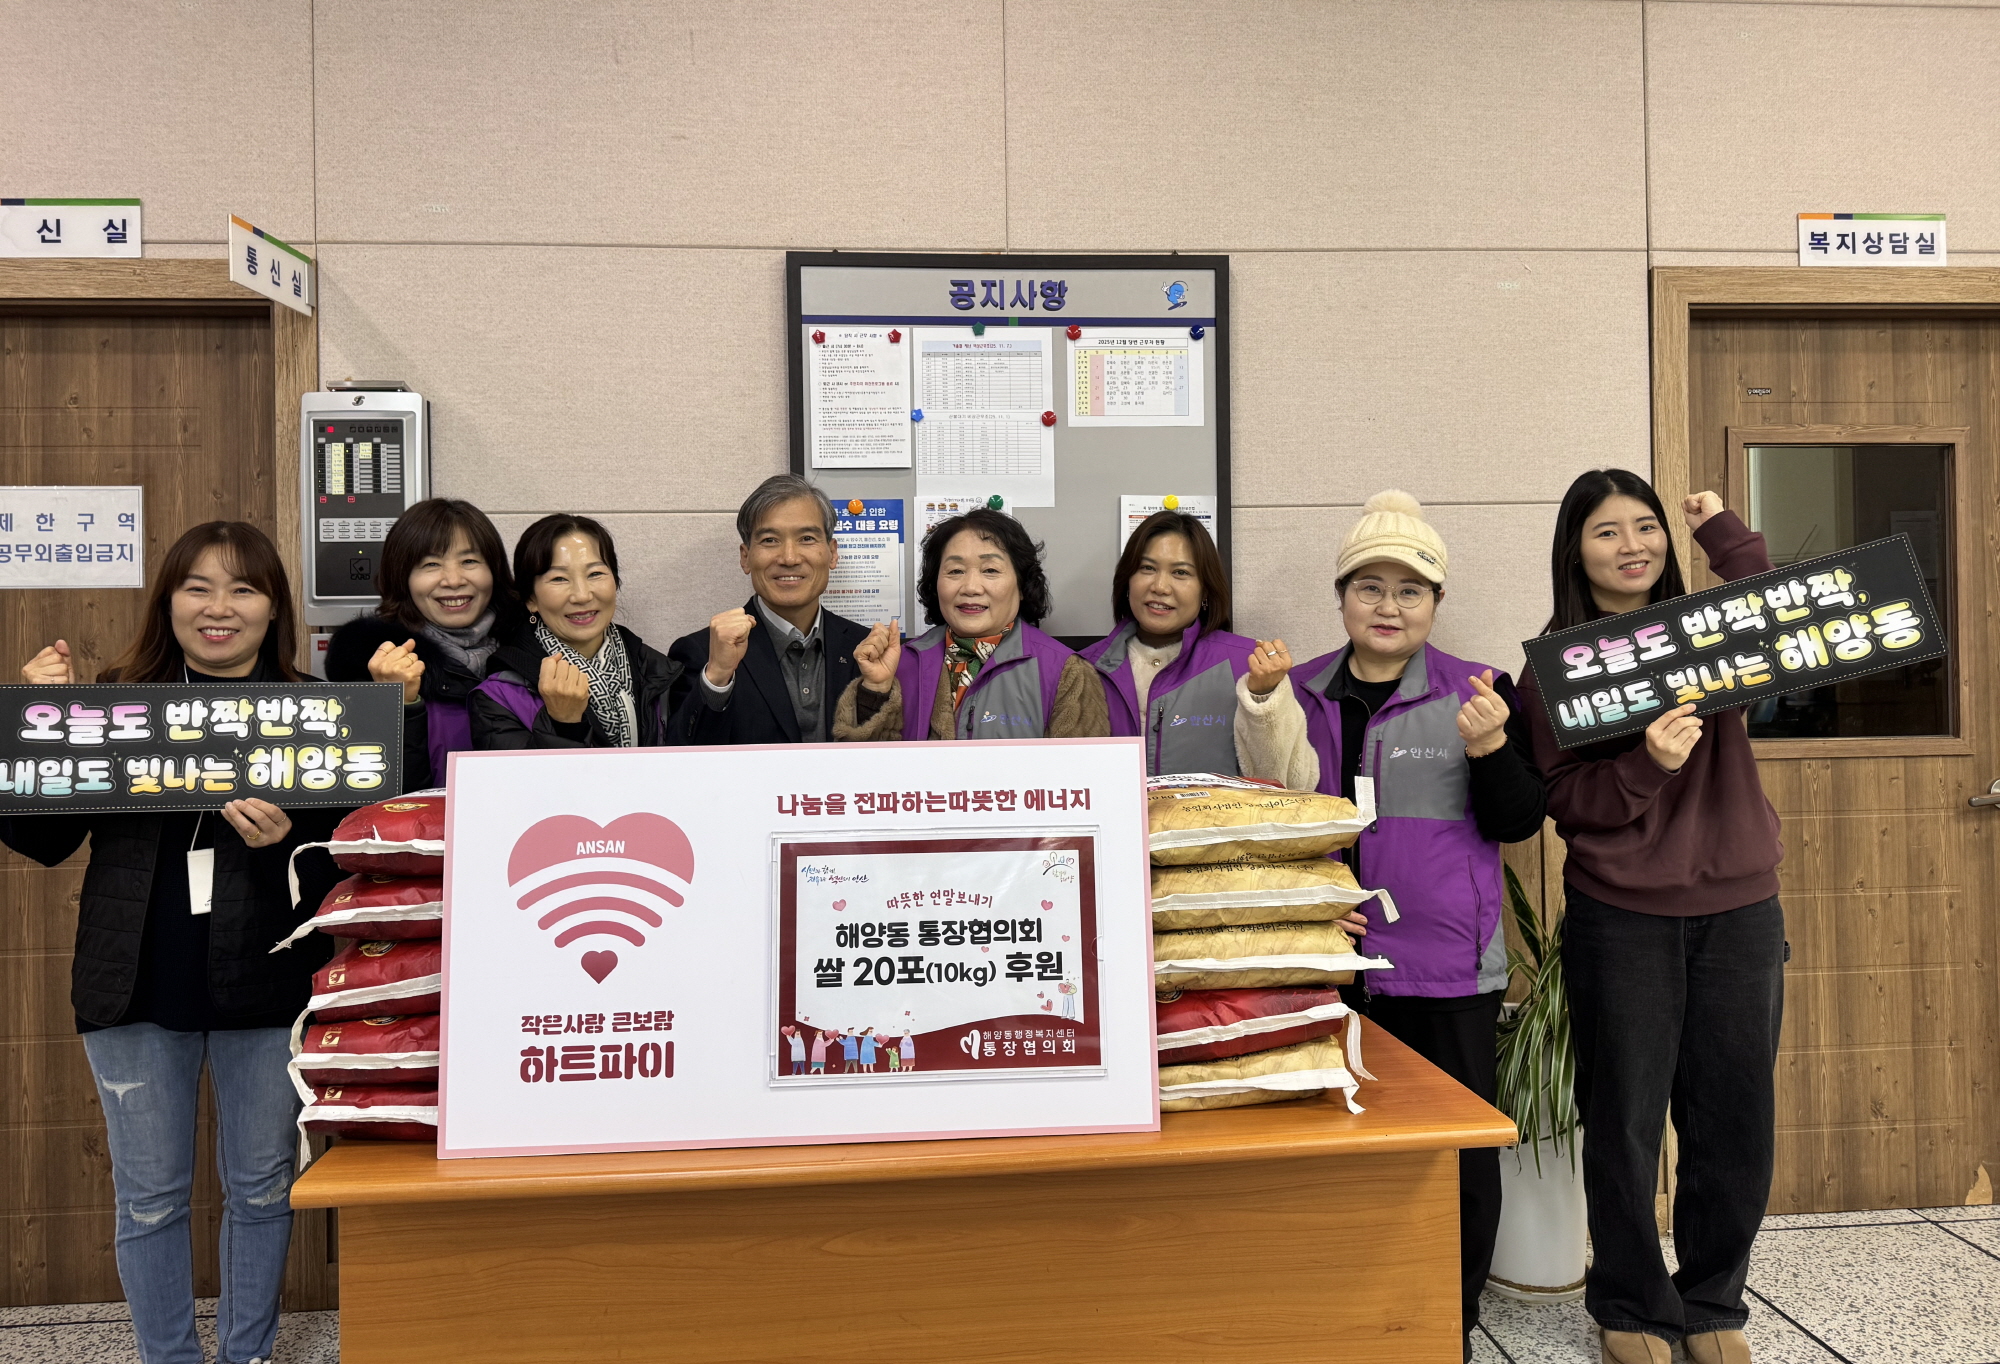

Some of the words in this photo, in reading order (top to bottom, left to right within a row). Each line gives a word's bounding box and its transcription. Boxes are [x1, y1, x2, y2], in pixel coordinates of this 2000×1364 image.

[36, 218, 62, 244] 신
[102, 218, 128, 244] 실
[1808, 231, 1936, 255] 복지상담실
[948, 279, 1069, 312] 공지사항
[35, 512, 56, 532] 한
[76, 512, 95, 532] 구
[117, 512, 135, 532] 역
[855, 519, 876, 531] 대응
[878, 519, 899, 531] 요령
[868, 507, 886, 517] 인한
[0, 543, 134, 564] 공무외출입금지
[1561, 622, 1680, 681] 오늘도
[1680, 566, 1868, 649] 반짝반짝,
[1557, 679, 1662, 729] 내일도
[1665, 651, 1773, 705] 빛나는
[1774, 600, 1922, 670] 해양동
[20, 702, 153, 745] 오늘도
[164, 696, 352, 741] 반짝반짝,
[1409, 746, 1448, 760] 안산시
[0, 757, 114, 796] 내일도
[126, 755, 238, 795] 빛나는
[247, 743, 387, 791] 해양동
[776, 792, 847, 816] 나눔을
[853, 789, 1018, 815] 전파하는따뜻한
[1023, 788, 1091, 811] 에너지
[576, 840, 626, 855] ANSAN
[886, 890, 925, 910] 따뜻한
[929, 888, 993, 909] 연말보내기
[835, 921, 910, 949] 해양동
[917, 917, 1043, 947] 통장협의회
[813, 956, 846, 988] 쌀
[852, 955, 997, 988] 20포(10kg)
[1004, 951, 1064, 982] 후원
[520, 1013, 606, 1036] 작은사랑
[611, 1010, 675, 1033] 큰보람
[982, 1028, 1076, 1041] 해양동행정복지센터
[519, 1040, 675, 1083] 하트파이
